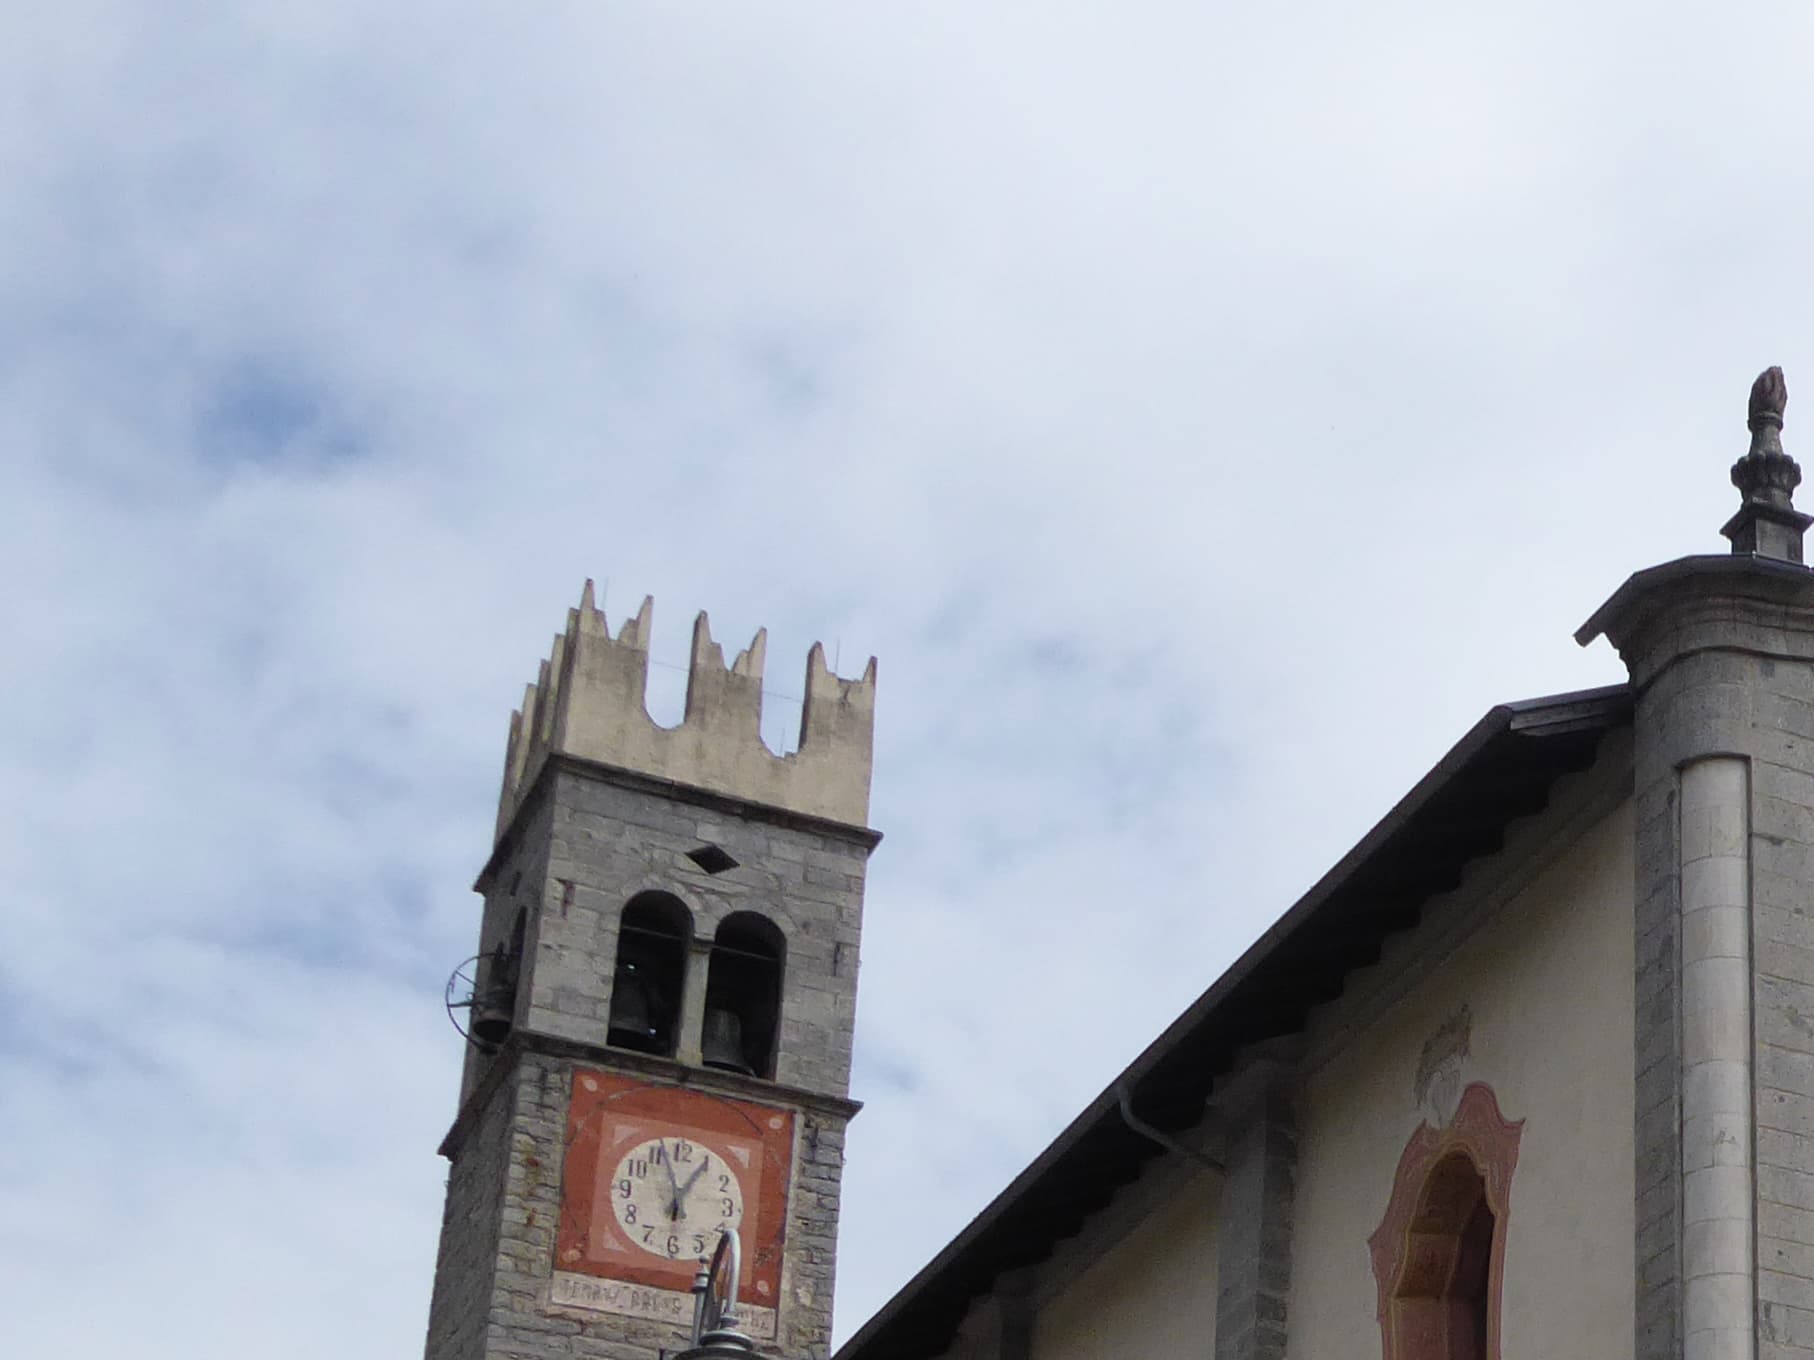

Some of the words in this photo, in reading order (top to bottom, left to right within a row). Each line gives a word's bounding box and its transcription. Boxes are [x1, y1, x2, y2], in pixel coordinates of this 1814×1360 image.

[648, 1146, 662, 1165] 11
[673, 1143, 693, 1163] 12
[627, 1159, 647, 1179] 10
[619, 1180, 632, 1199] 9
[719, 1174, 729, 1193] 2
[624, 1204, 637, 1225] 8
[722, 1197, 734, 1217] 3
[642, 1224, 656, 1242] 7
[667, 1235, 680, 1255] 6
[693, 1234, 705, 1254] 5
